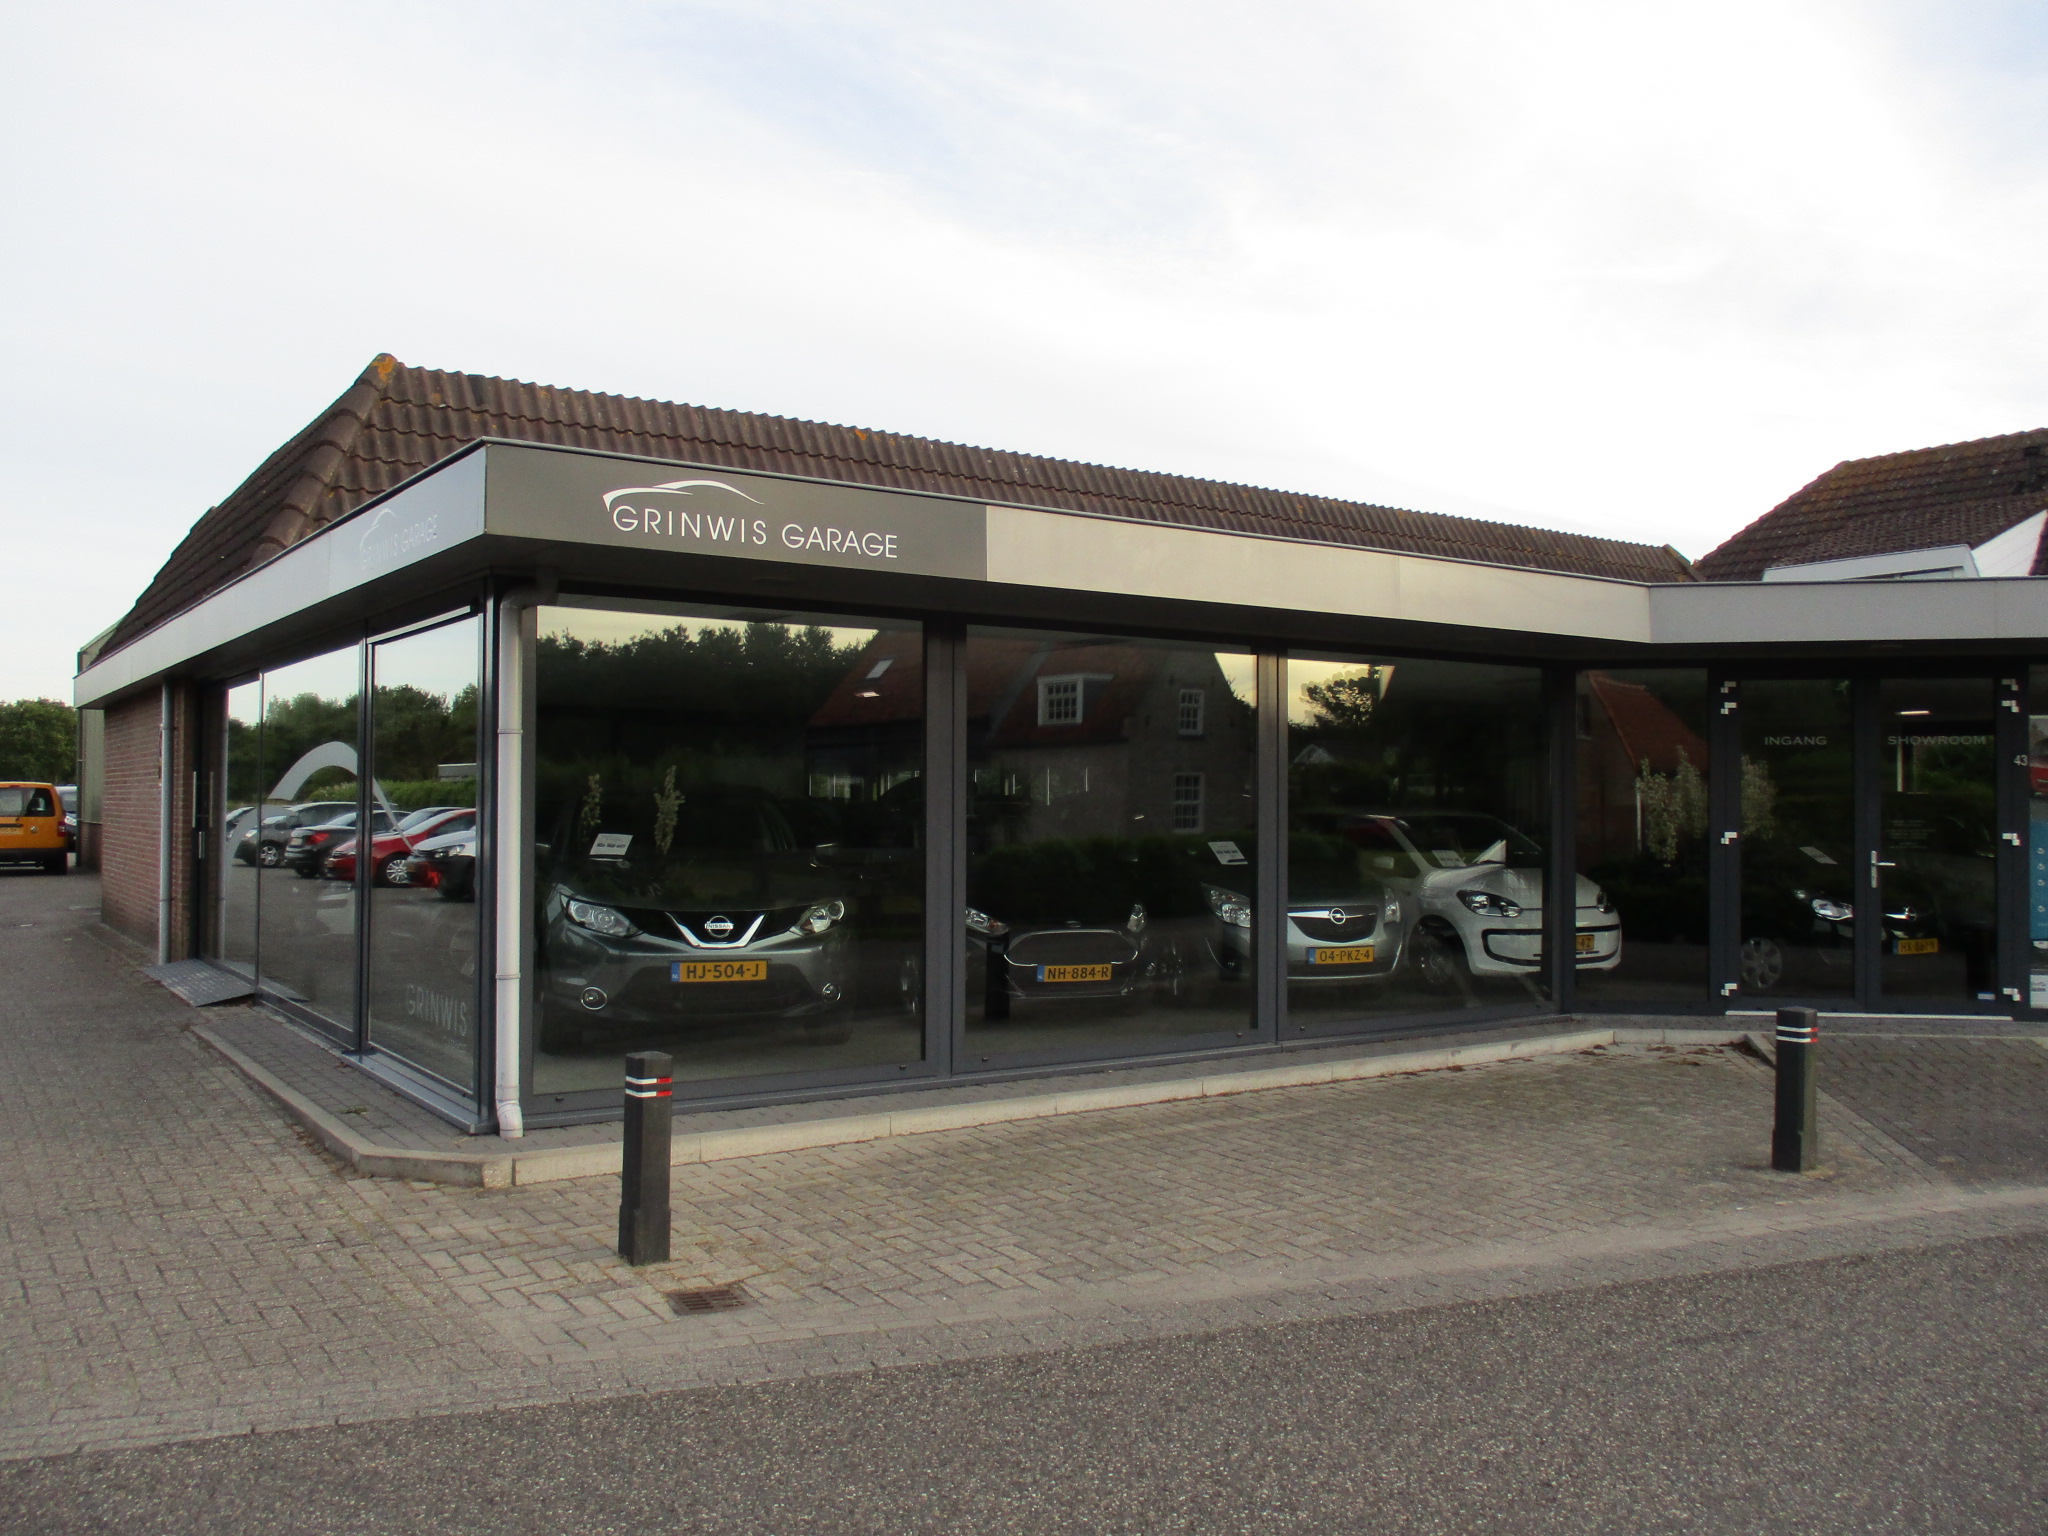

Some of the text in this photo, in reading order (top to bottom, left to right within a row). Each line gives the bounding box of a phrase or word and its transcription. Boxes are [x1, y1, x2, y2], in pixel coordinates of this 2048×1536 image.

[402, 513, 438, 553] GARAGE
[613, 505, 898, 559] GRINWIS GARAGE
[1764, 735, 1828, 746] INGANG
[1887, 735, 1987, 746] SHOWROOM
[2013, 754, 2029, 767] 43
[1319, 949, 1371, 962] 04-PKZ-4
[686, 963, 760, 979] HJ-504-J
[1047, 965, 1109, 980] NH-884-R
[406, 983, 468, 1037] GRINWIS
